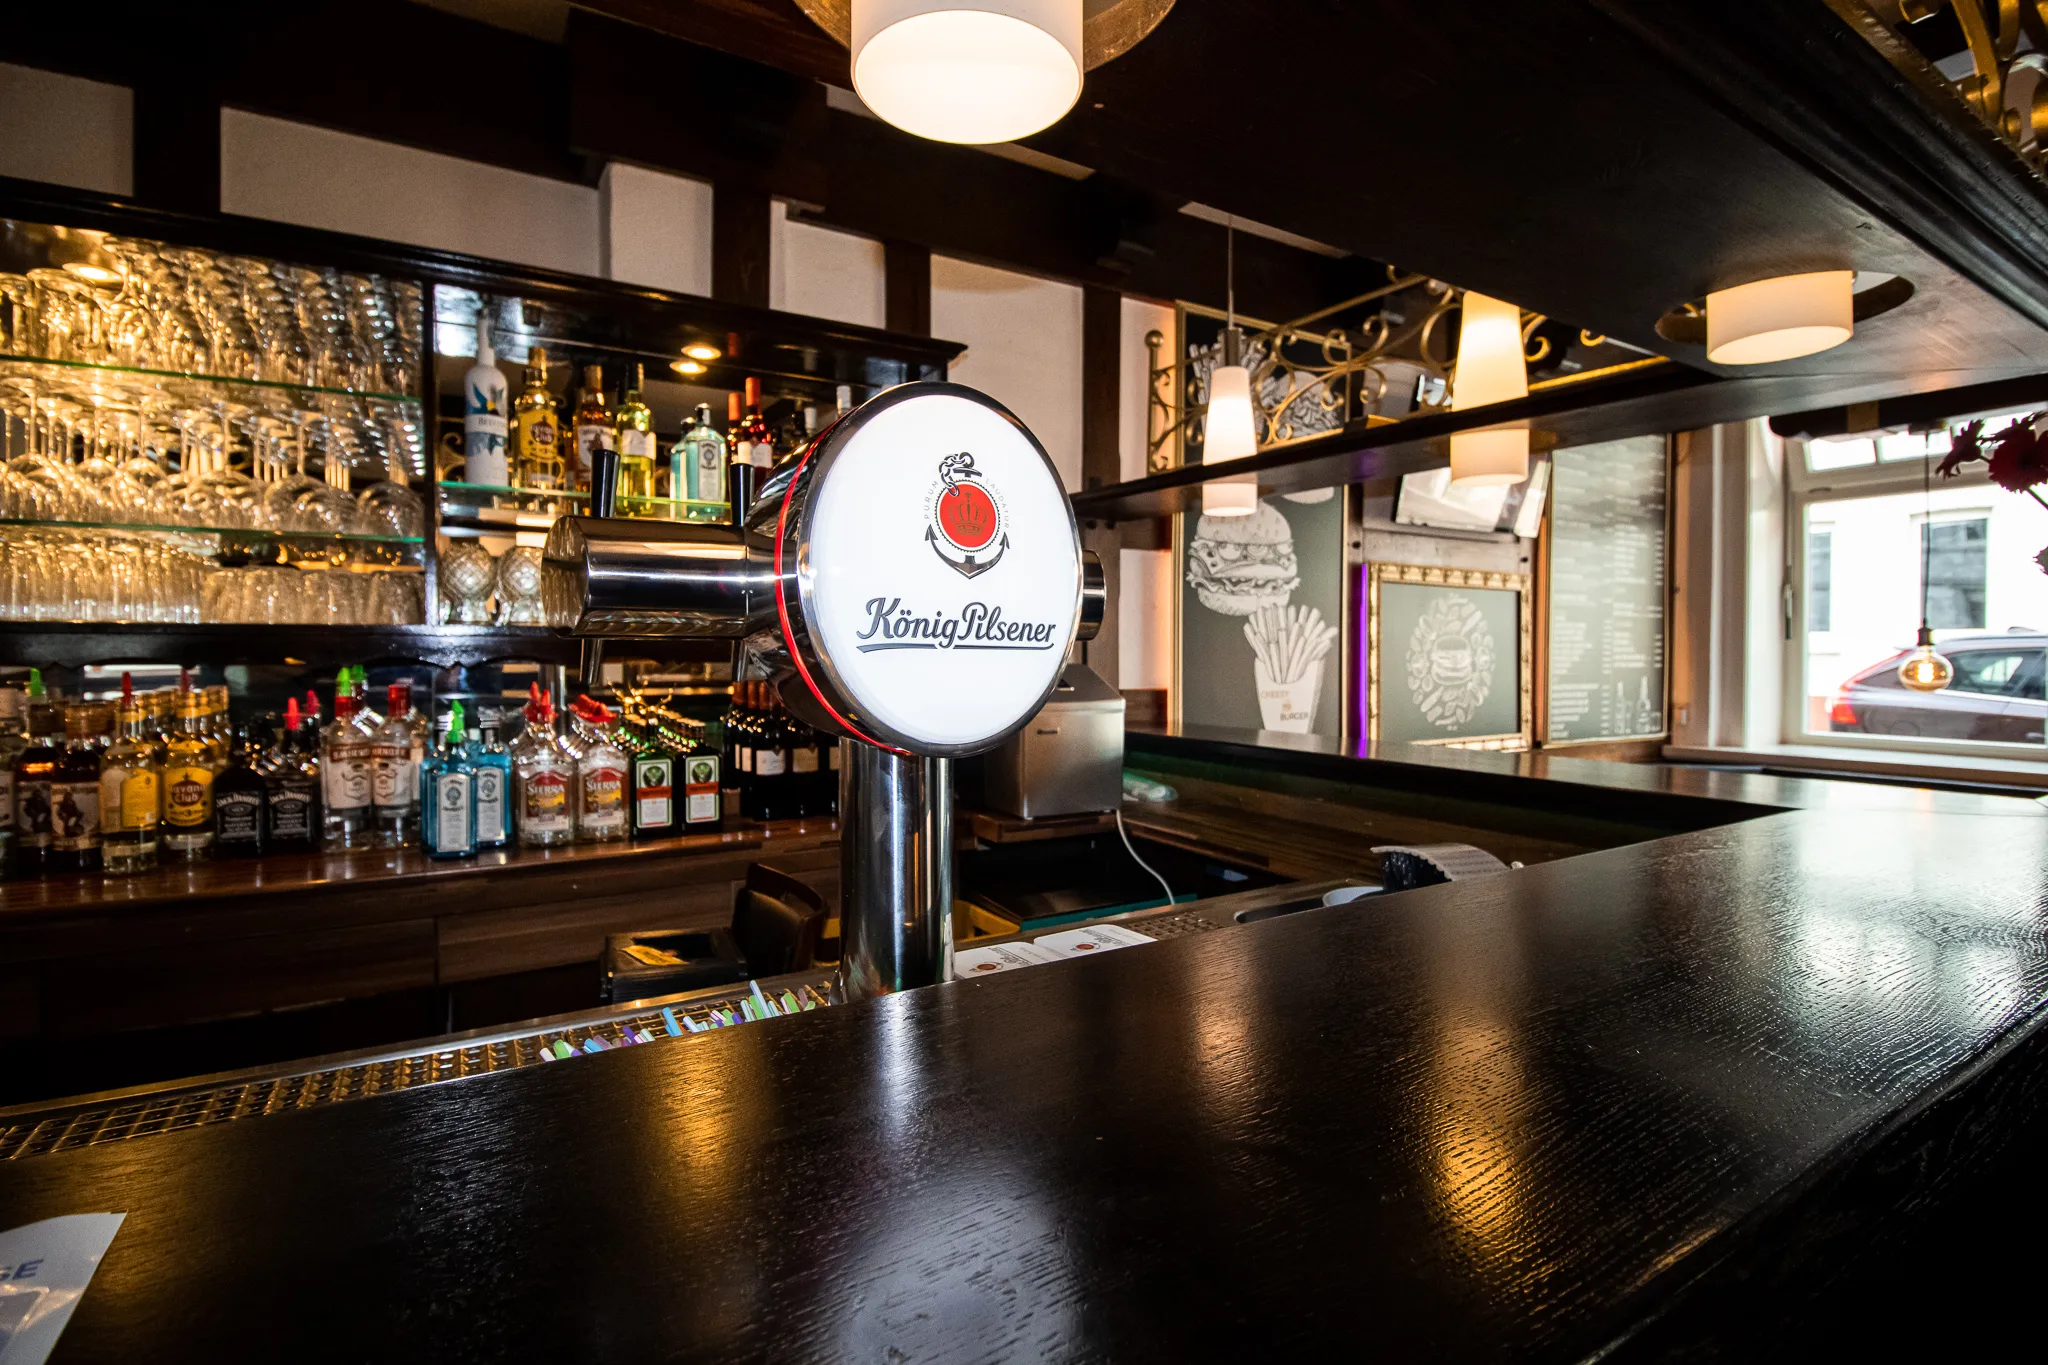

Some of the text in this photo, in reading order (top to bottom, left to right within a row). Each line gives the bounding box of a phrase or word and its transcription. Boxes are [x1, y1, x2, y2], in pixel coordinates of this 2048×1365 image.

[923, 480, 940, 520] PURUM
[856, 597, 1056, 649] König Pilsener
[527, 784, 565, 794] SIERRA
[586, 780, 621, 791] SIERRA
